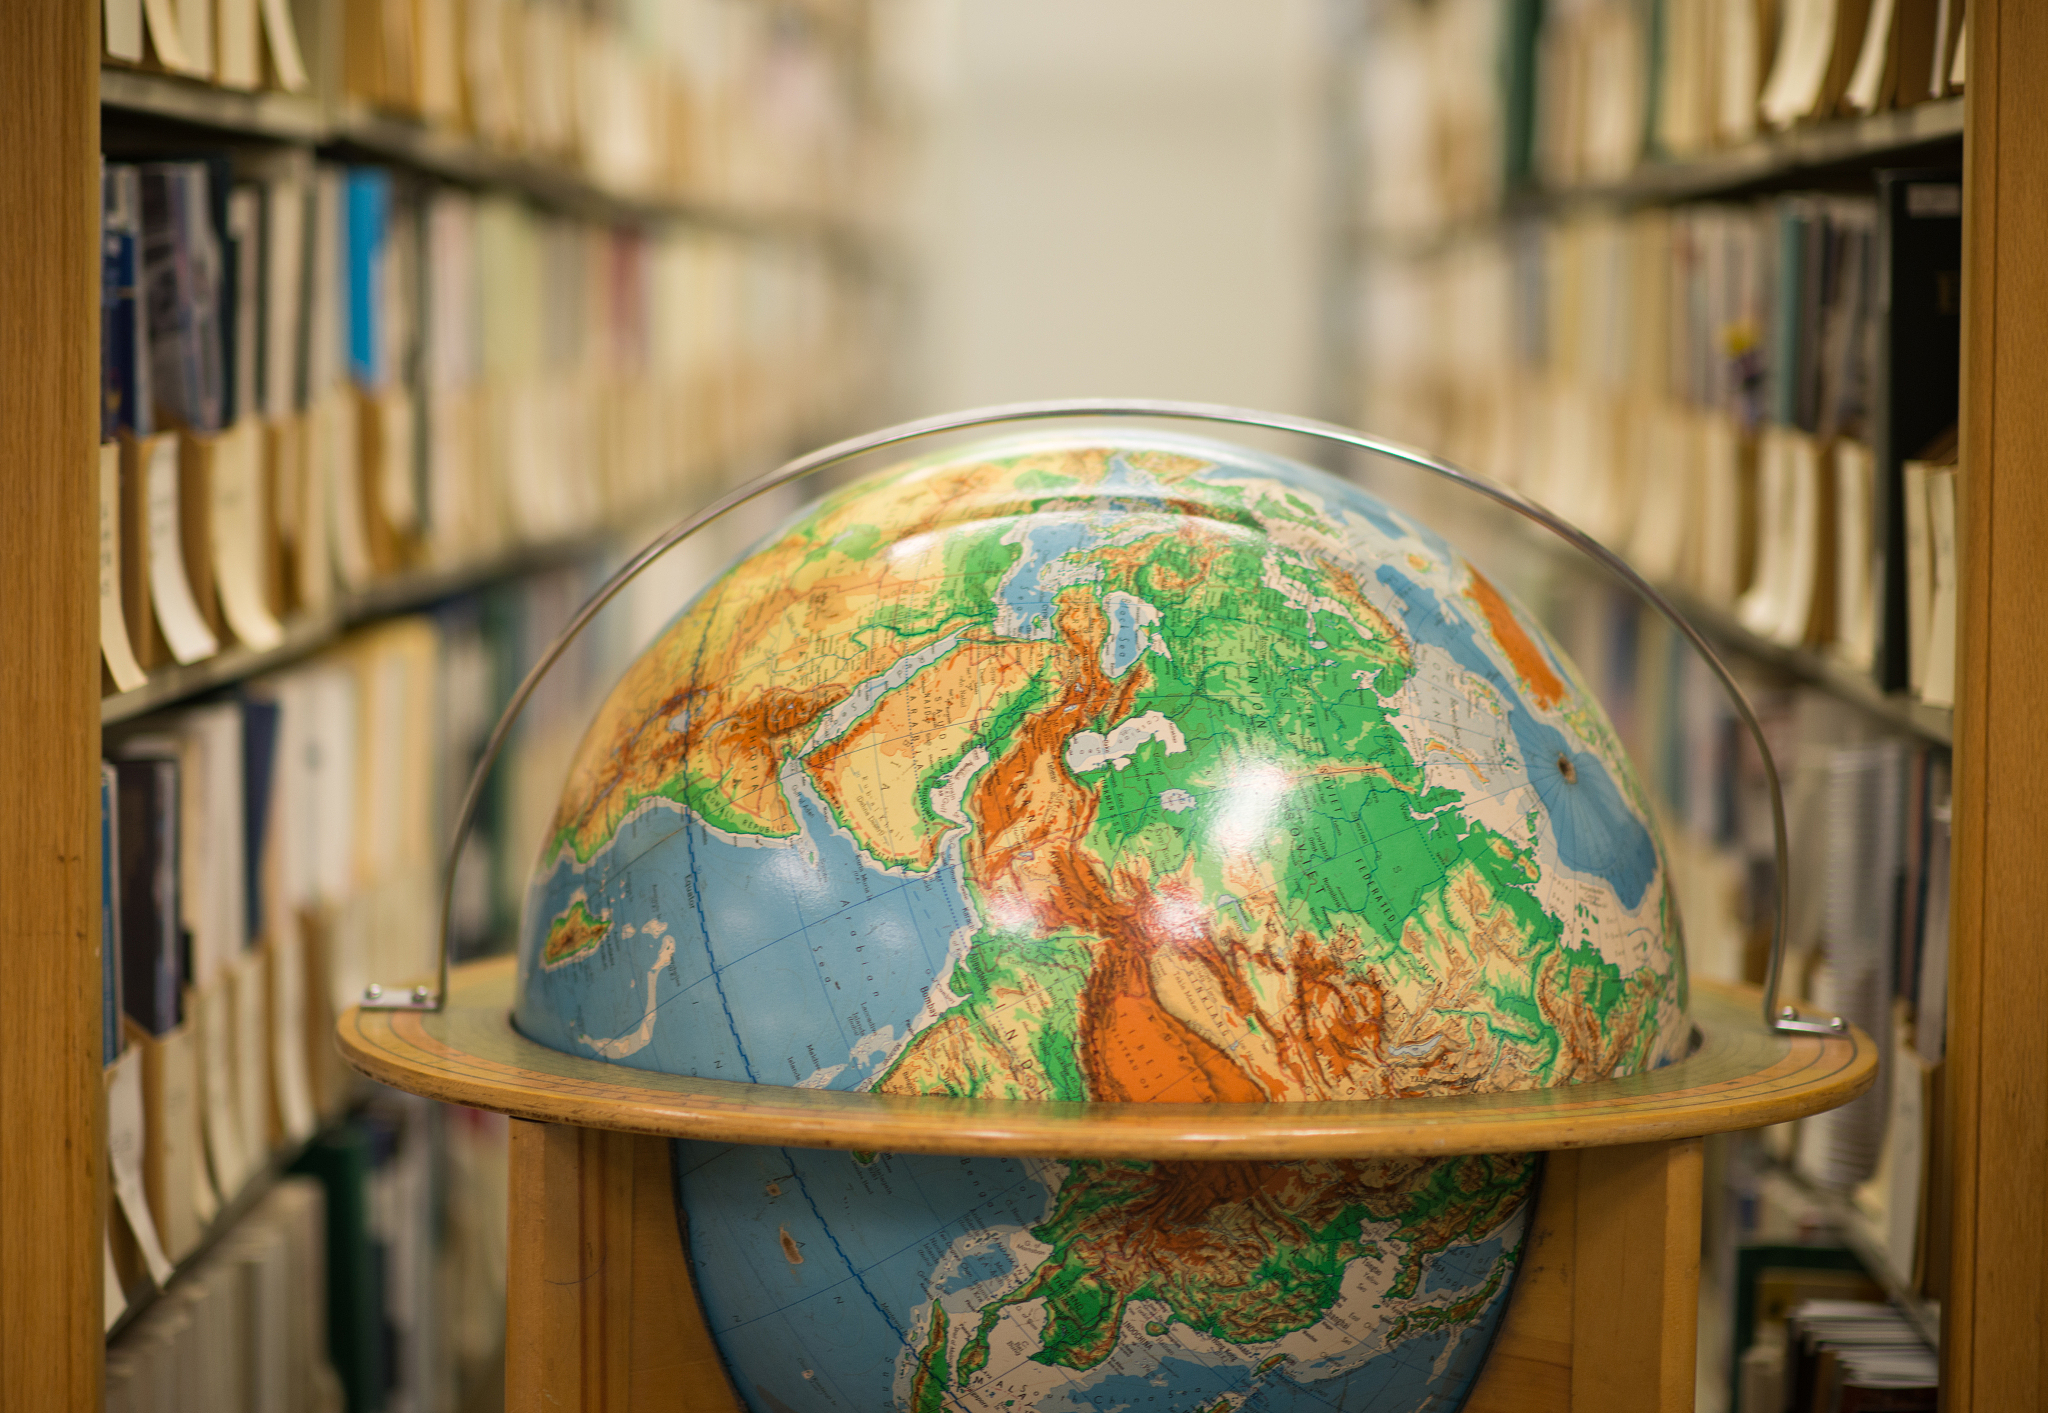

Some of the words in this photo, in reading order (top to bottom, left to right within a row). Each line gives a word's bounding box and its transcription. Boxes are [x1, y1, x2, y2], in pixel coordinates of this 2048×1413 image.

[1246, 662, 1267, 728] UNION
[684, 873, 696, 909] Equator
[1049, 850, 1076, 910] AFGHANISTAN
[1355, 858, 1396, 922] FEDERATED
[962, 907, 975, 931] Karachi
[813, 944, 831, 983] Sea
[840, 900, 880, 998] Arabian
[920, 985, 938, 1018] Bombay
[996, 1003, 1048, 1096] INDI
[960, 1157, 1001, 1215] Bengal
